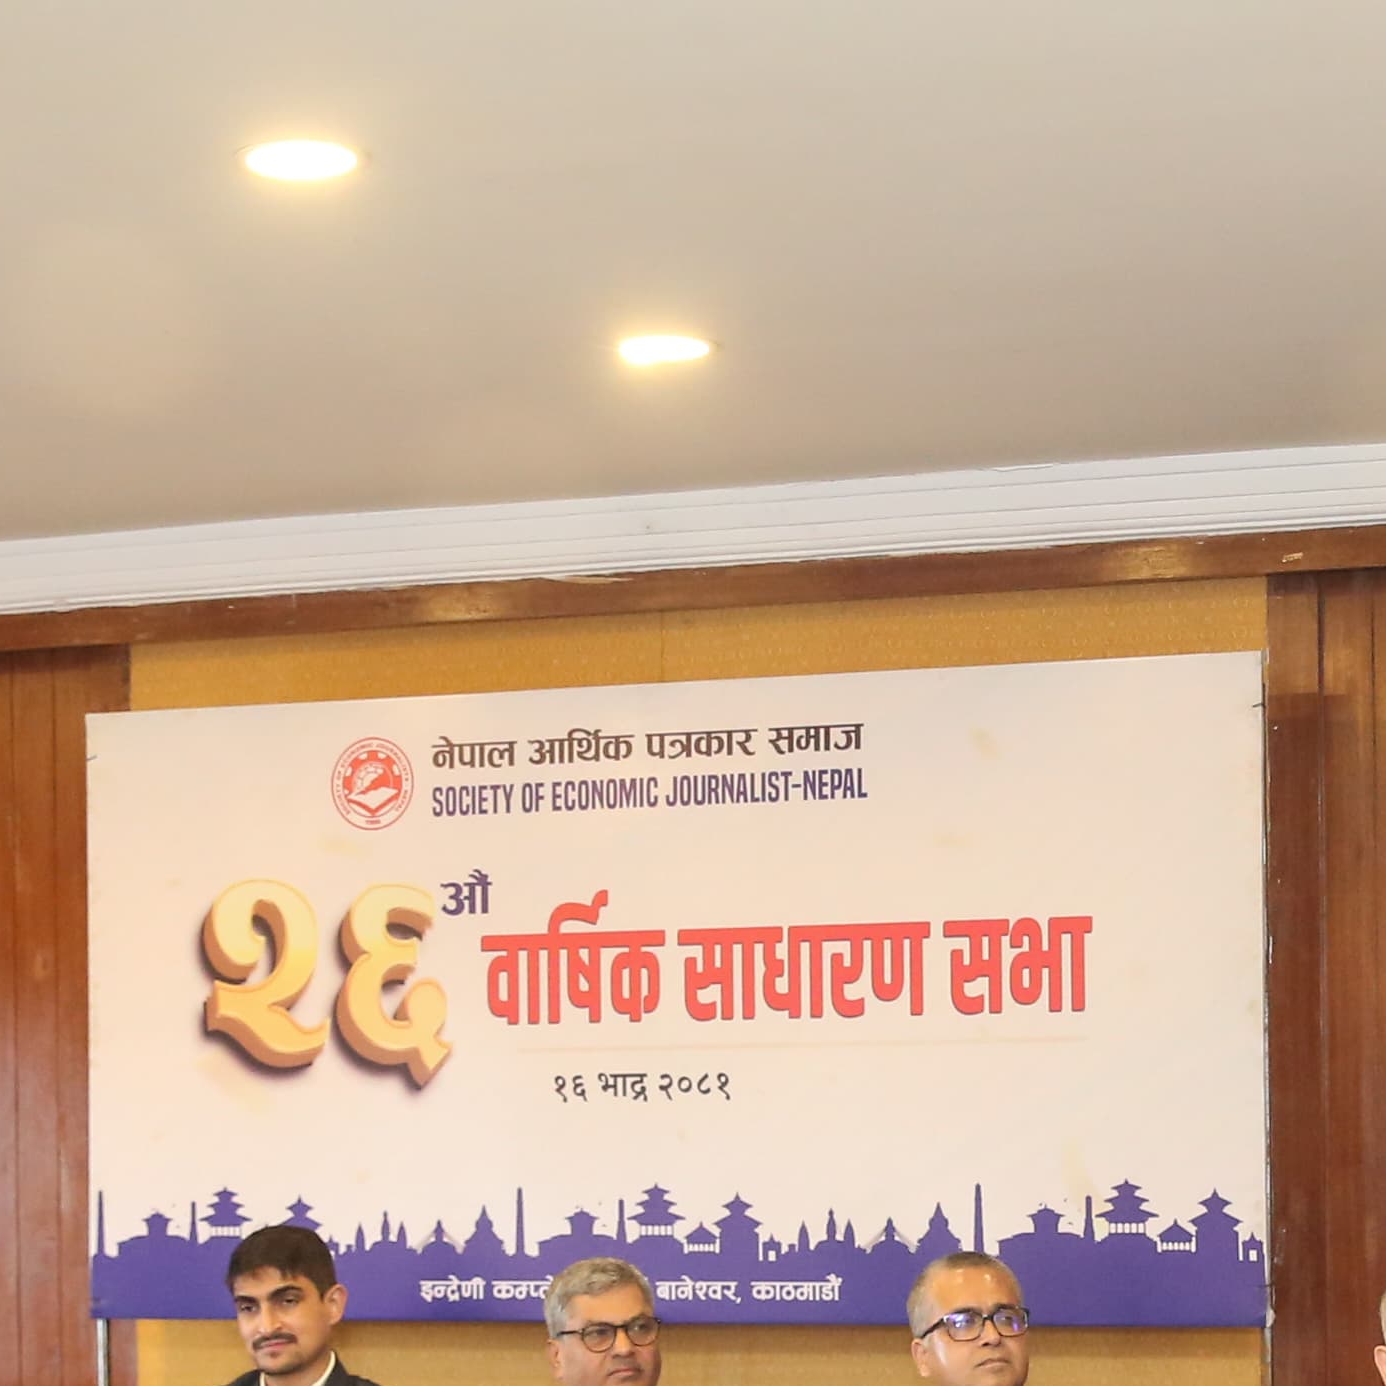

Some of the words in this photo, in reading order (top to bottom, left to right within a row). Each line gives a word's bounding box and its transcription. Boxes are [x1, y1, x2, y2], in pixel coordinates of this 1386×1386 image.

[431, 735, 517, 769] नेपाल
[527, 727, 636, 766] आर्थिक
[645, 728, 758, 760] पत्रकार
[768, 723, 865, 755] समाज
[432, 783, 514, 817] SOCIETY
[521, 782, 545, 813] OF
[552, 775, 659, 812] ECONOMIC
[665, 767, 868, 807] JOURNALIST-NEPAL
[201, 879, 453, 1090] २६
[481, 889, 666, 1025] वार्षिक
[677, 921, 931, 1022] साधारण
[943, 916, 1093, 1016] सभा
[554, 1074, 588, 1103] १६
[597, 1072, 648, 1102] भाद्र
[658, 1072, 731, 1101] २०८१
[420, 1274, 486, 1302] इन्द्रेणी
[655, 1275, 742, 1304] बानेश्वर,
[751, 1273, 842, 1301] काठमाडौं
